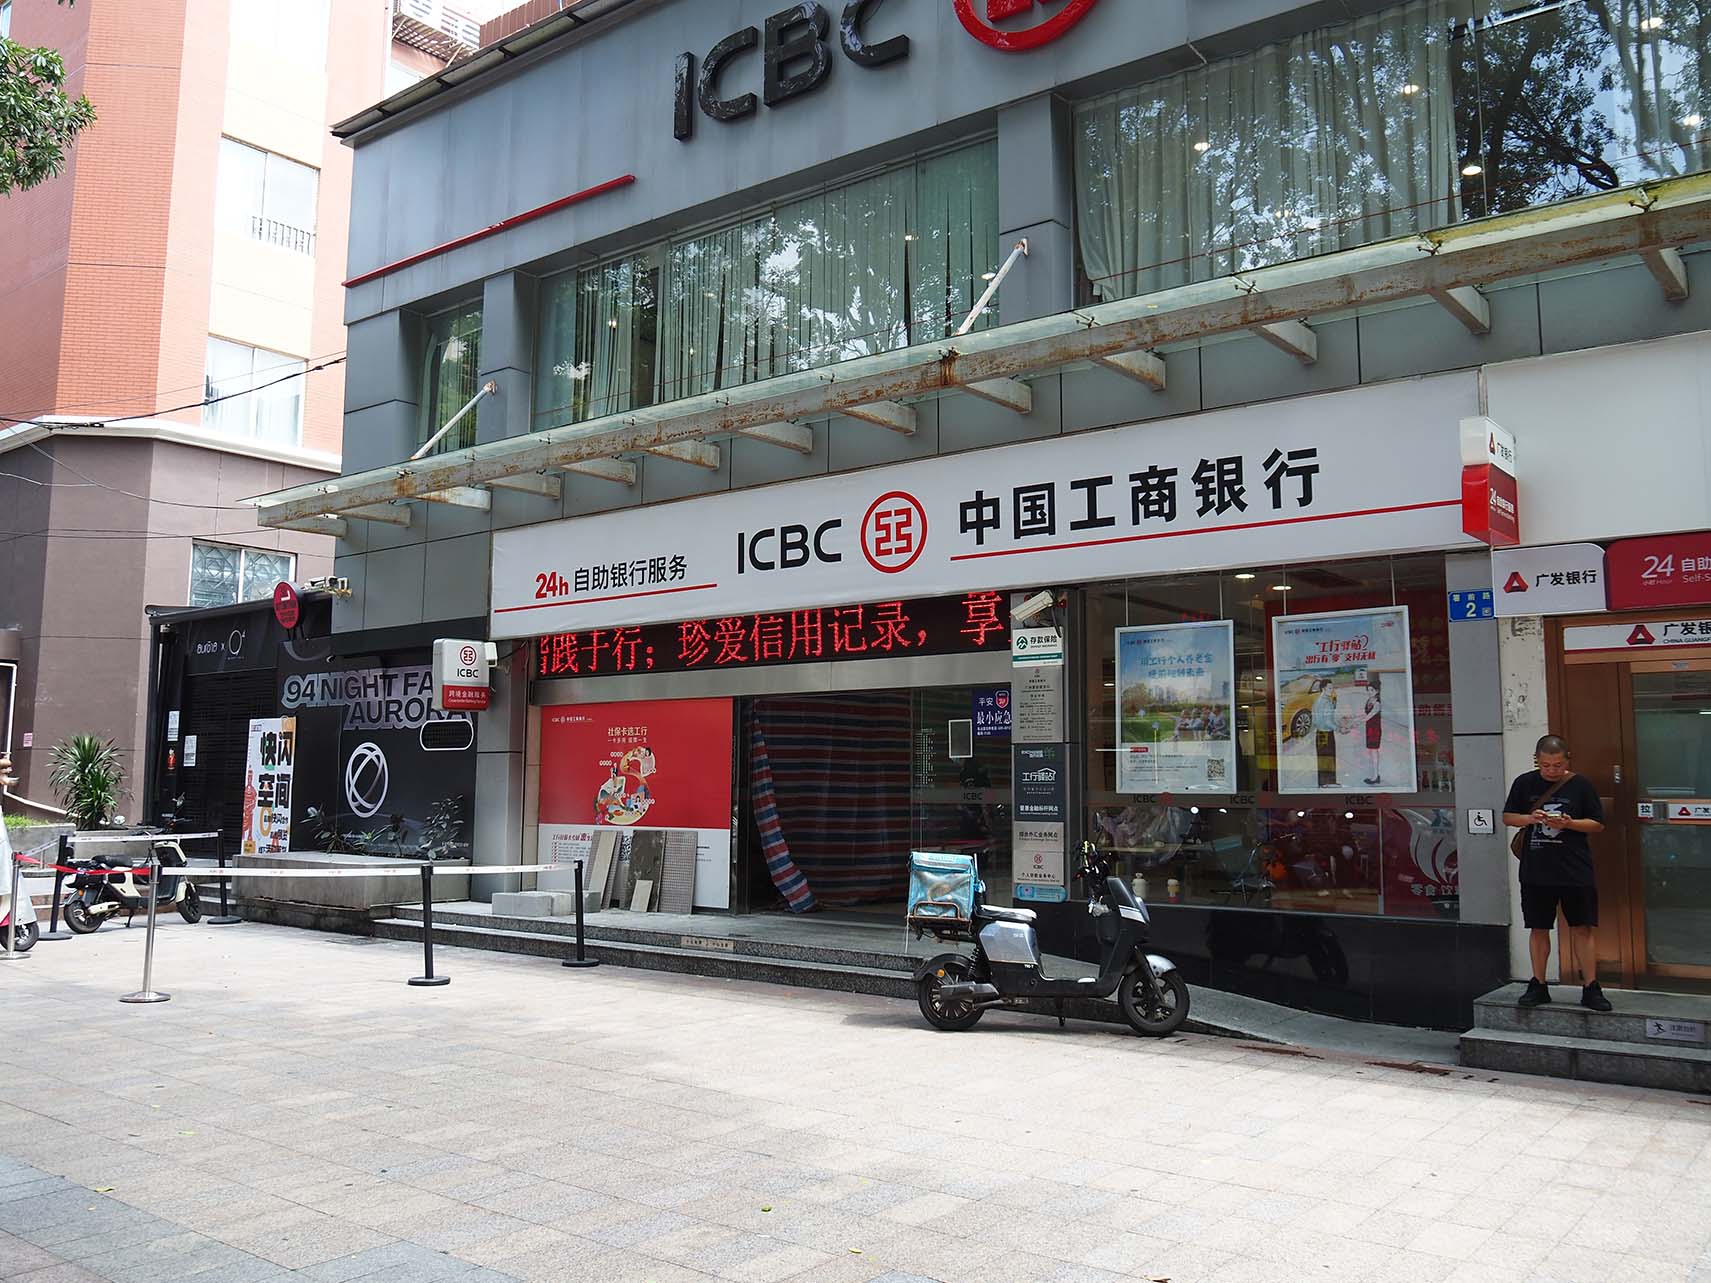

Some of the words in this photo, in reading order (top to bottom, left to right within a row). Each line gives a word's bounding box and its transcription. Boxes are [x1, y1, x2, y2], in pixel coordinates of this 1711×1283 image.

[673, 0, 910, 141] ICBC
[959, 448, 1320, 545] 中国工商银行
[738, 519, 842, 574] ICBC
[1641, 554, 1675, 578] 24
[535, 571, 569, 599] 24h
[574, 554, 687, 592] 自助银行服务
[1535, 570, 1597, 588] 广发银行
[1466, 602, 1477, 617] 2
[1030, 634, 1057, 644] 存款保险
[457, 668, 479, 678] ICBC
[286, 679, 316, 702] 94
[321, 673, 399, 700] NIGHT
[978, 697, 994, 706] 平安
[260, 731, 293, 766] 快闪
[257, 773, 291, 808] 空间
[964, 792, 982, 800] ICBC
[1133, 795, 1155, 803] ICBC
[1230, 795, 1255, 804] ICBC
[1641, 804, 1651, 813] 拉
